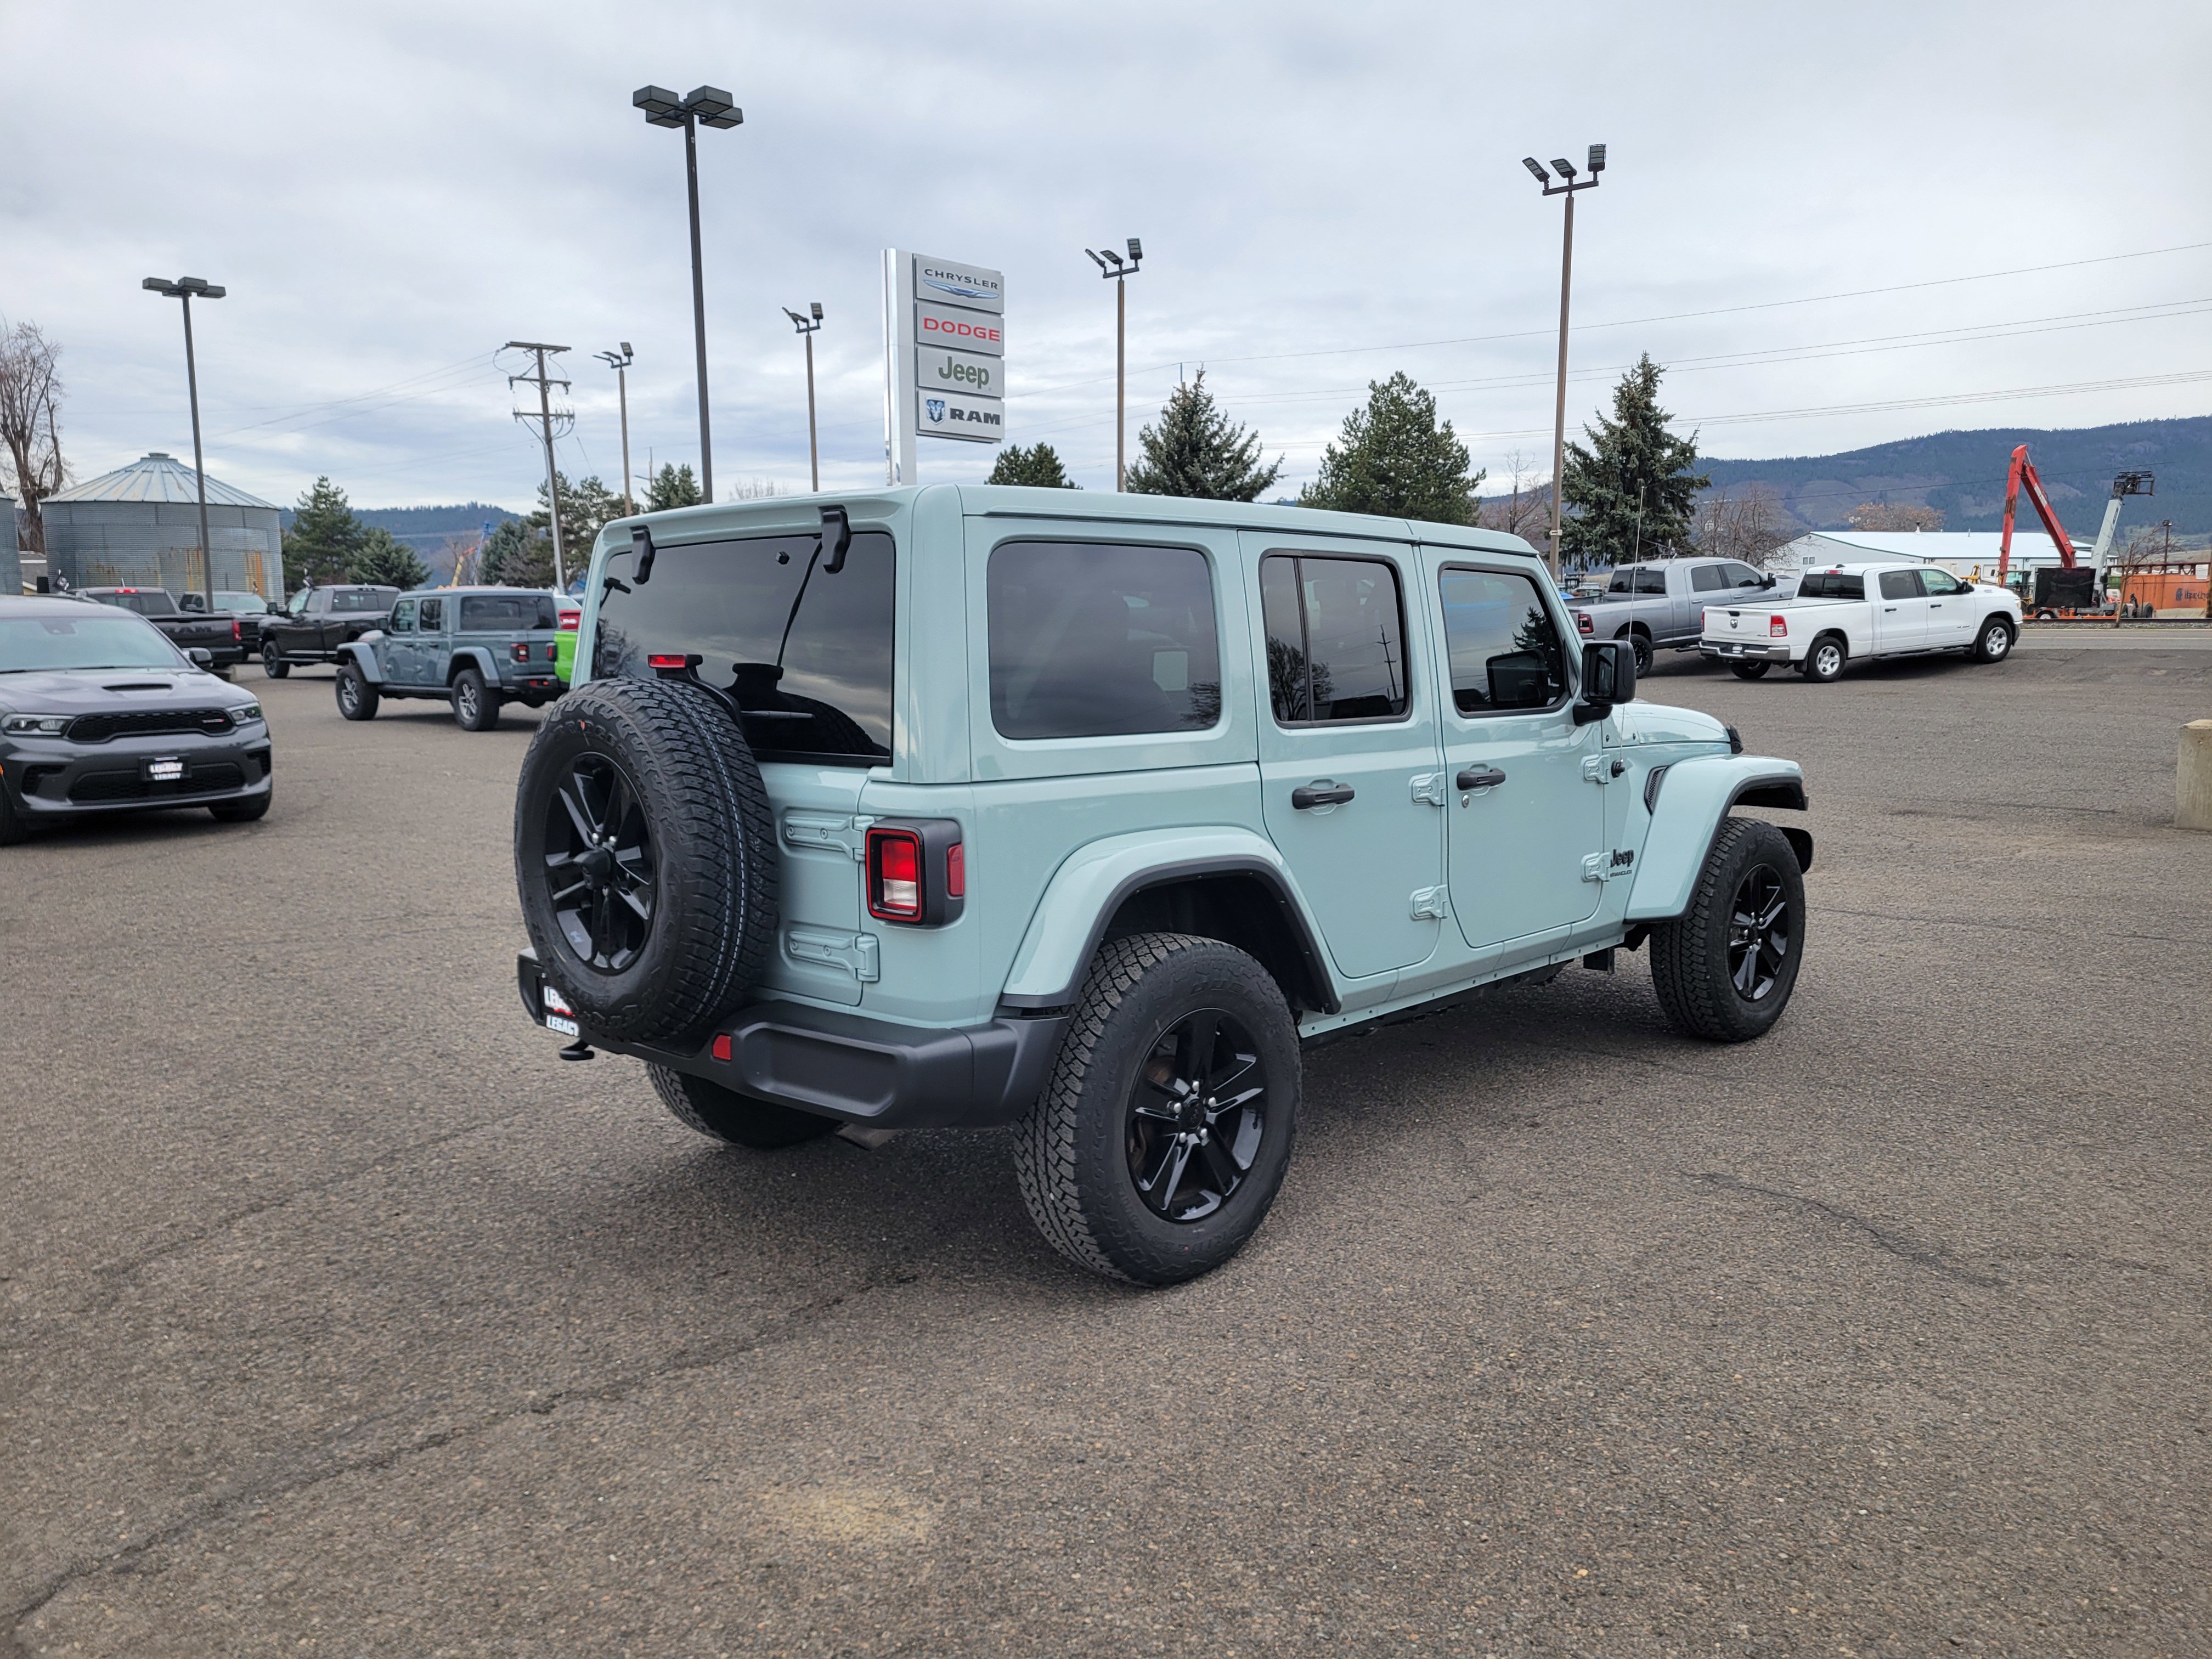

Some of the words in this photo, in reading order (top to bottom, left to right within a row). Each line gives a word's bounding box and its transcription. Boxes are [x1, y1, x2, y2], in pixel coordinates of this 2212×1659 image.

[924, 269, 998, 290] CHRYSLER
[923, 317, 1001, 342] DODGE
[938, 356, 989, 389] Jeep
[950, 408, 1001, 426] RAM
[1610, 849, 1634, 867] Jeep
